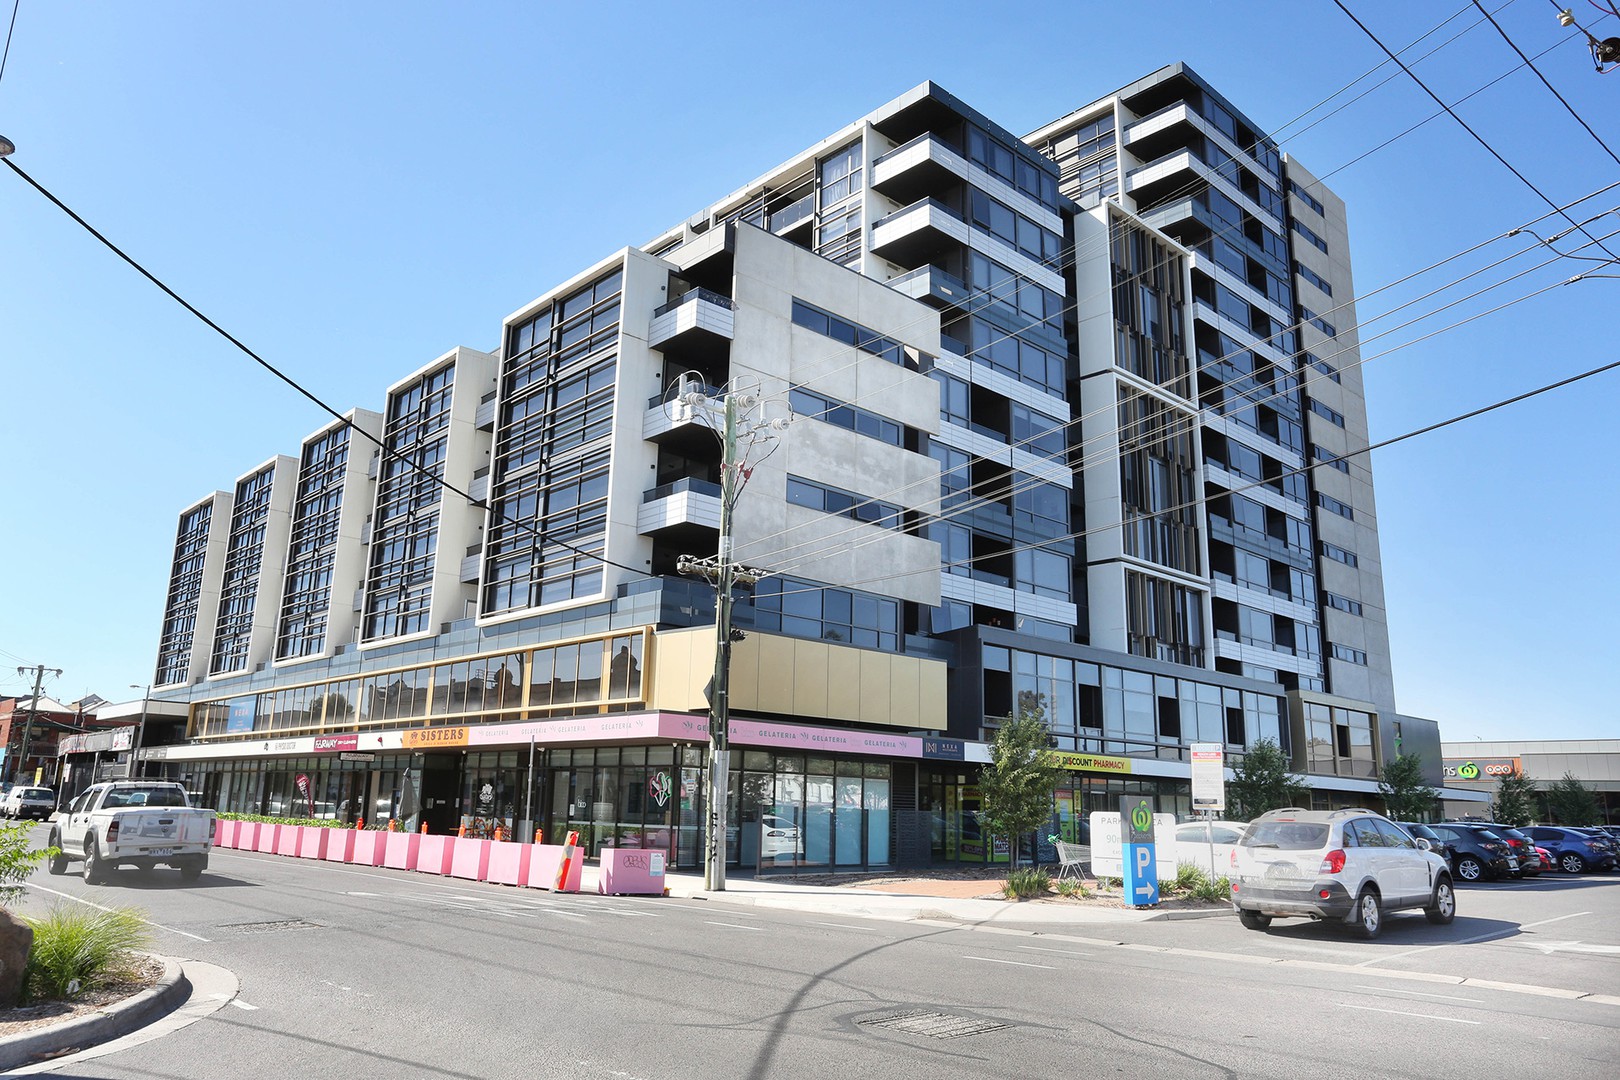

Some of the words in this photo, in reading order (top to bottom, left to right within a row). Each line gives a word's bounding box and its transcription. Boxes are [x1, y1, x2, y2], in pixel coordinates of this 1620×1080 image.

[521, 727, 547, 735] GELATERIA
[558, 725, 586, 734] GELATERIA
[601, 722, 632, 731] GELATERIA
[420, 729, 464, 741] SISTERS
[758, 730, 797, 740] GELATERIA
[811, 734, 847, 744] GELATERIA
[864, 739, 896, 748] GELATERIA
[1062, 756, 1092, 767] DISCOUNT
[1093, 759, 1125, 770] PHARMACY
[1137, 847, 1151, 878] P
